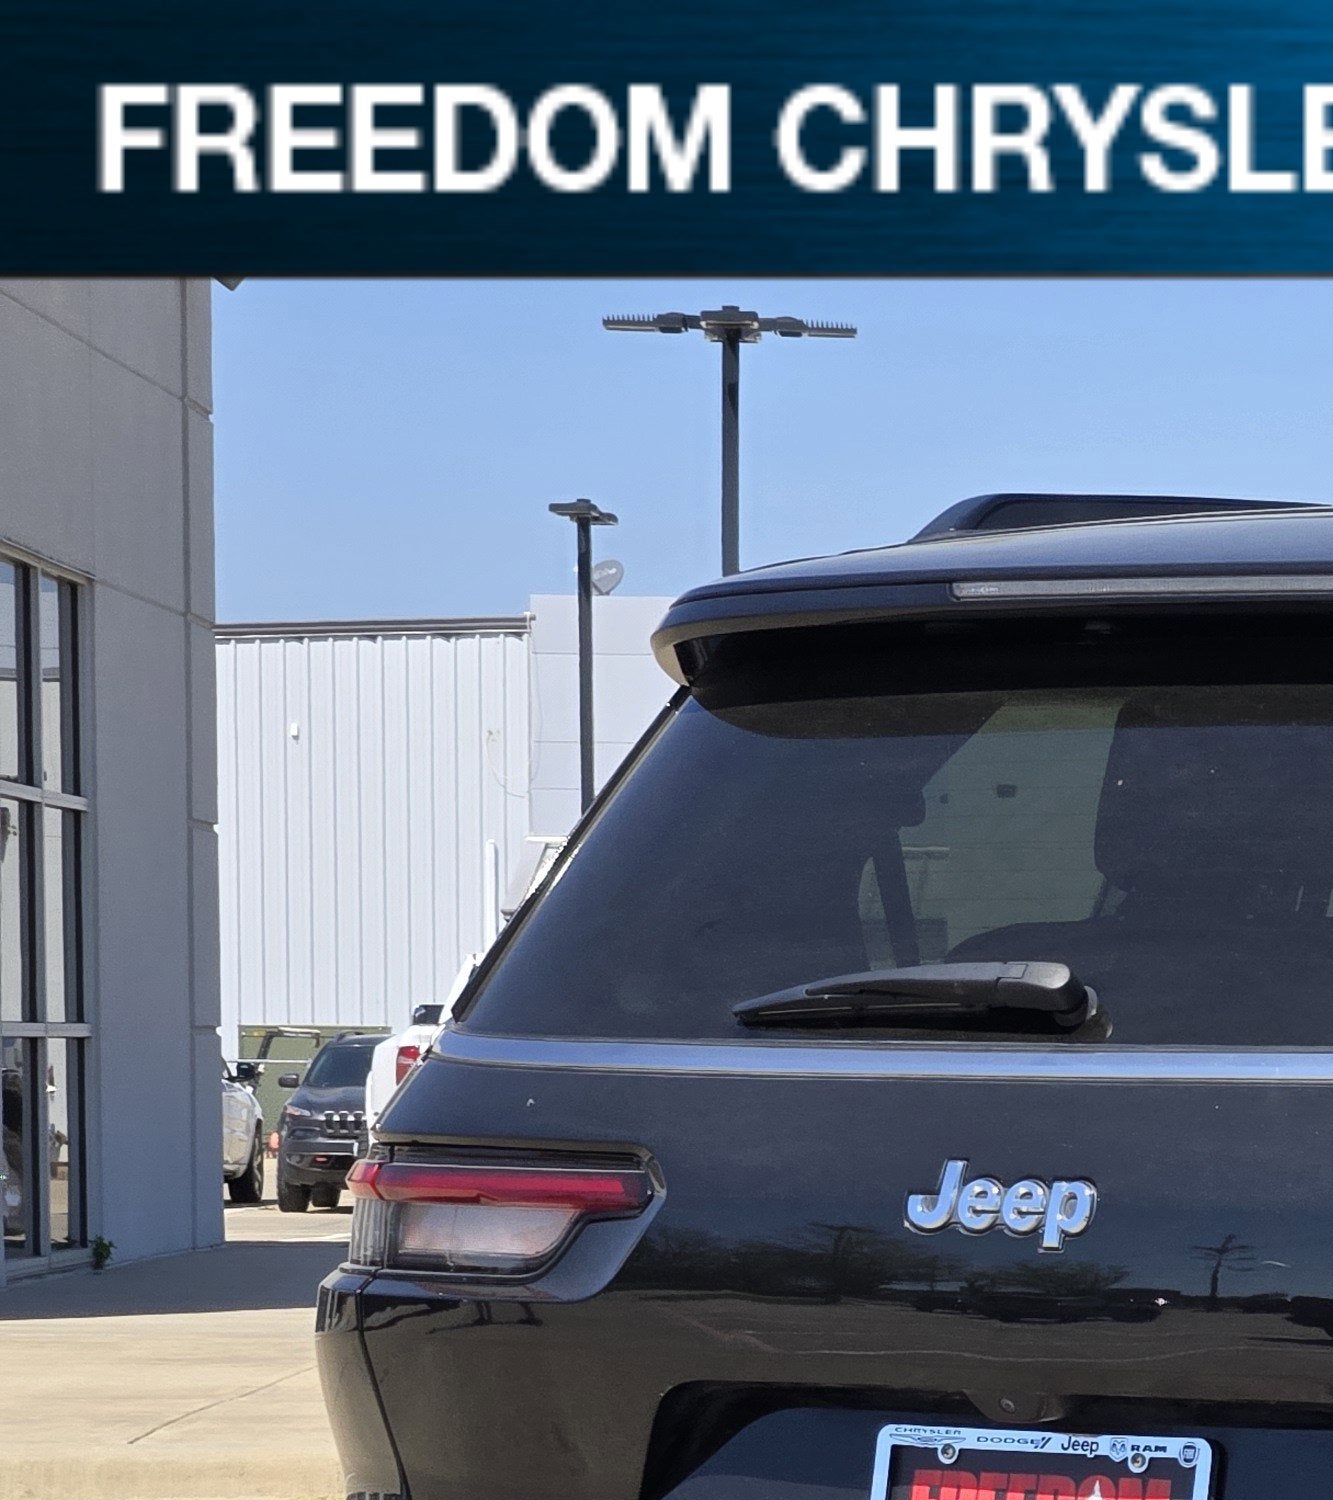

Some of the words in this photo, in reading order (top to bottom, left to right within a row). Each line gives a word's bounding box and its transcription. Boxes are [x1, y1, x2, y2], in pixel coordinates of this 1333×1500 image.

[903, 1158, 1098, 1253] Jeep
[894, 1427, 962, 1436] CHRYSLER
[1060, 1435, 1100, 1455] Jeep
[1130, 1443, 1168, 1453] RAM
